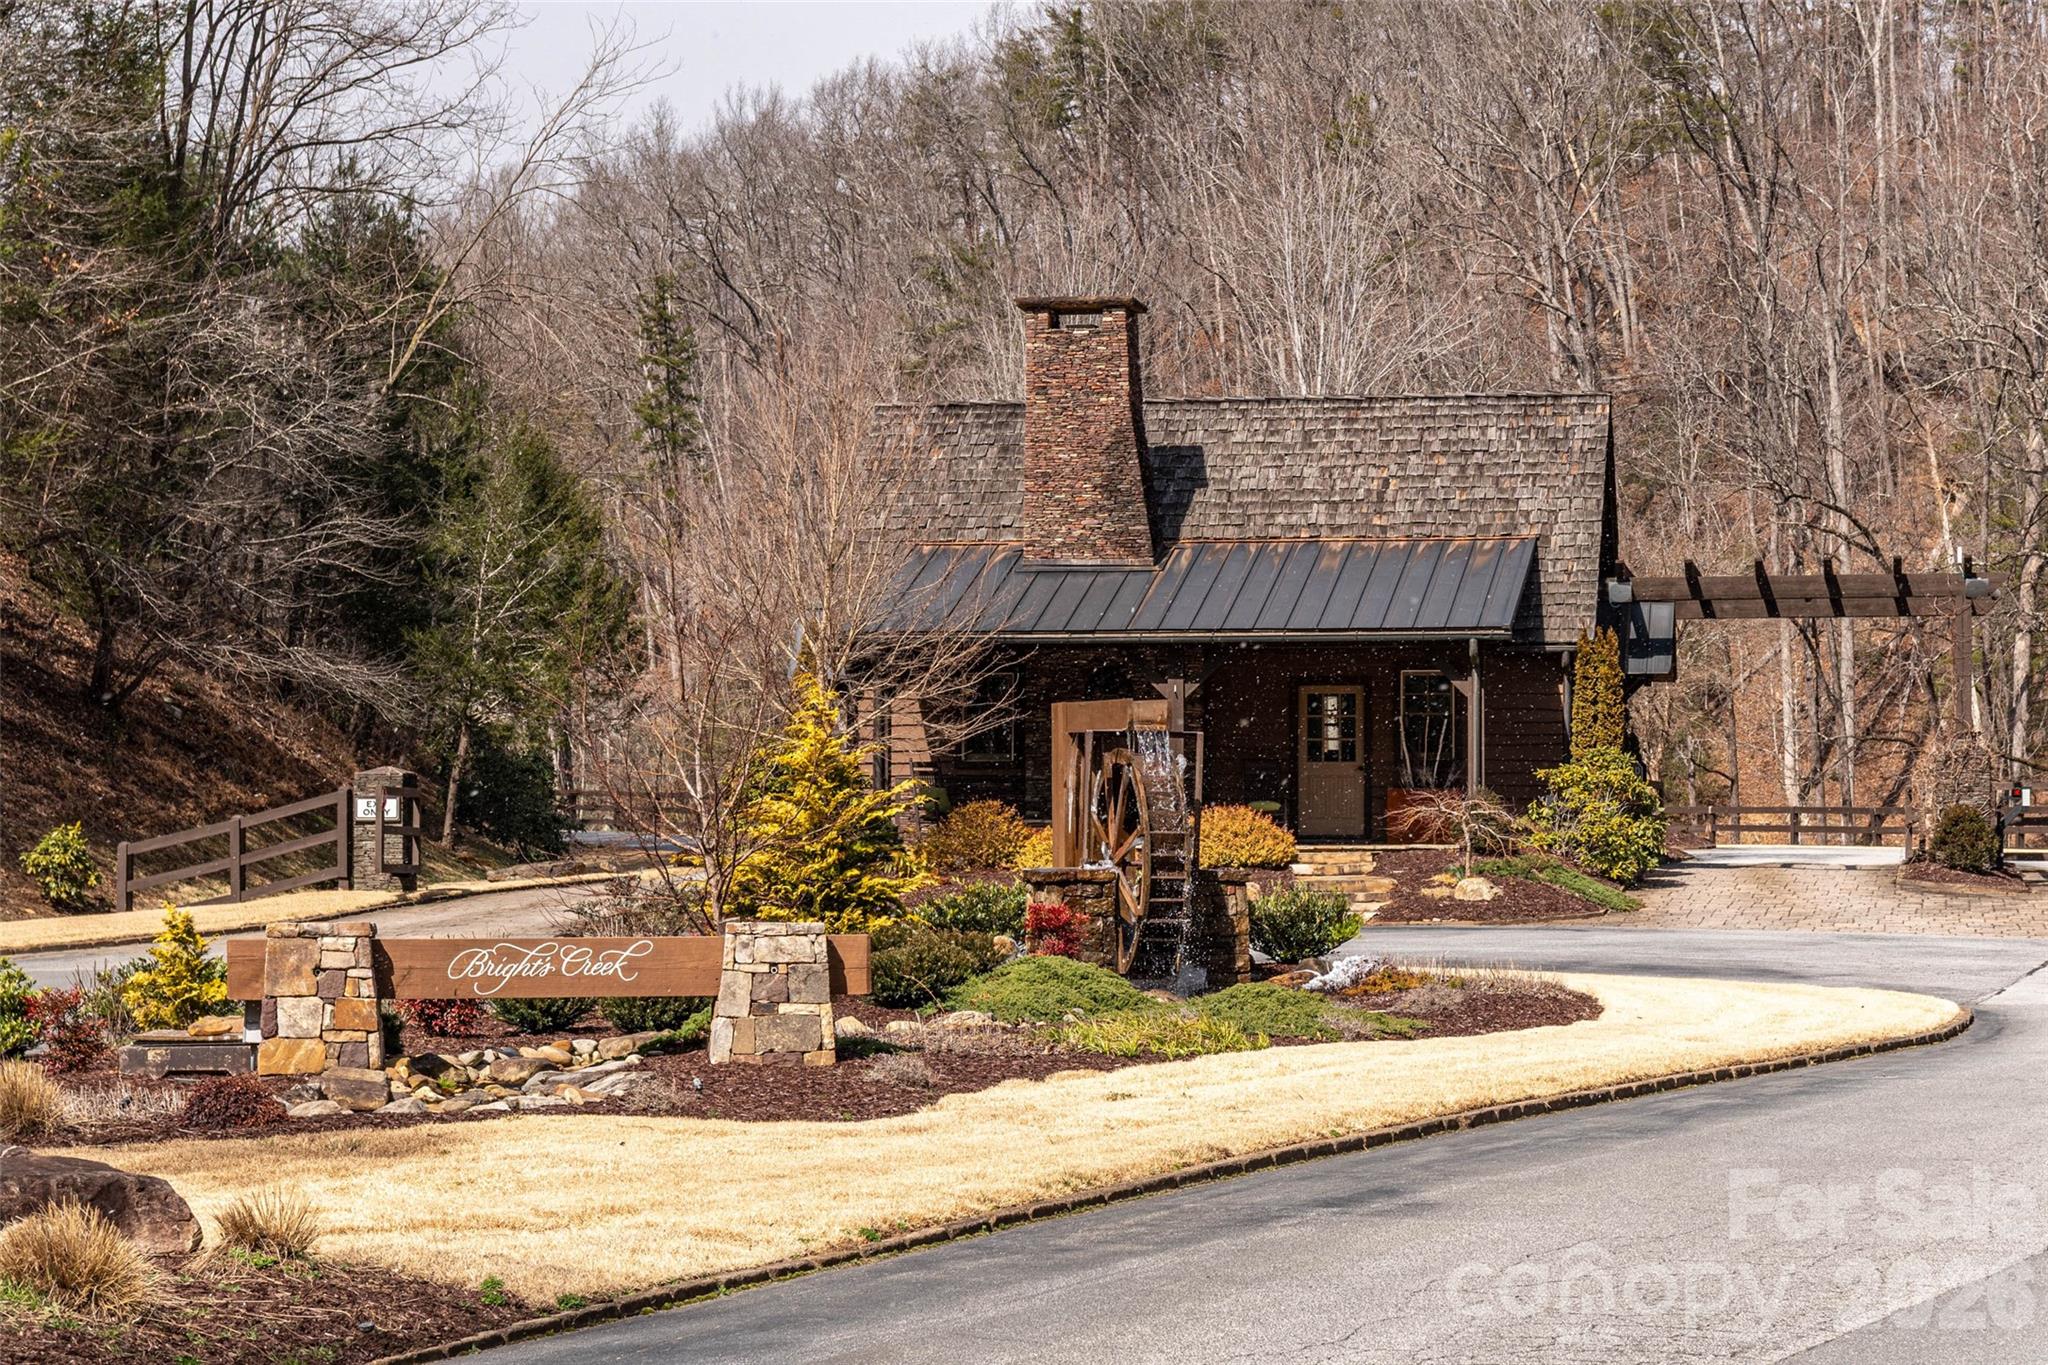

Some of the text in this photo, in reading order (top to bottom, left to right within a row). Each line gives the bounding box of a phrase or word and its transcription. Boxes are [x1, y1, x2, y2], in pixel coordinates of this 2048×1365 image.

[363, 808, 391, 816] ONY
[447, 940, 654, 996] Bright's Creek
